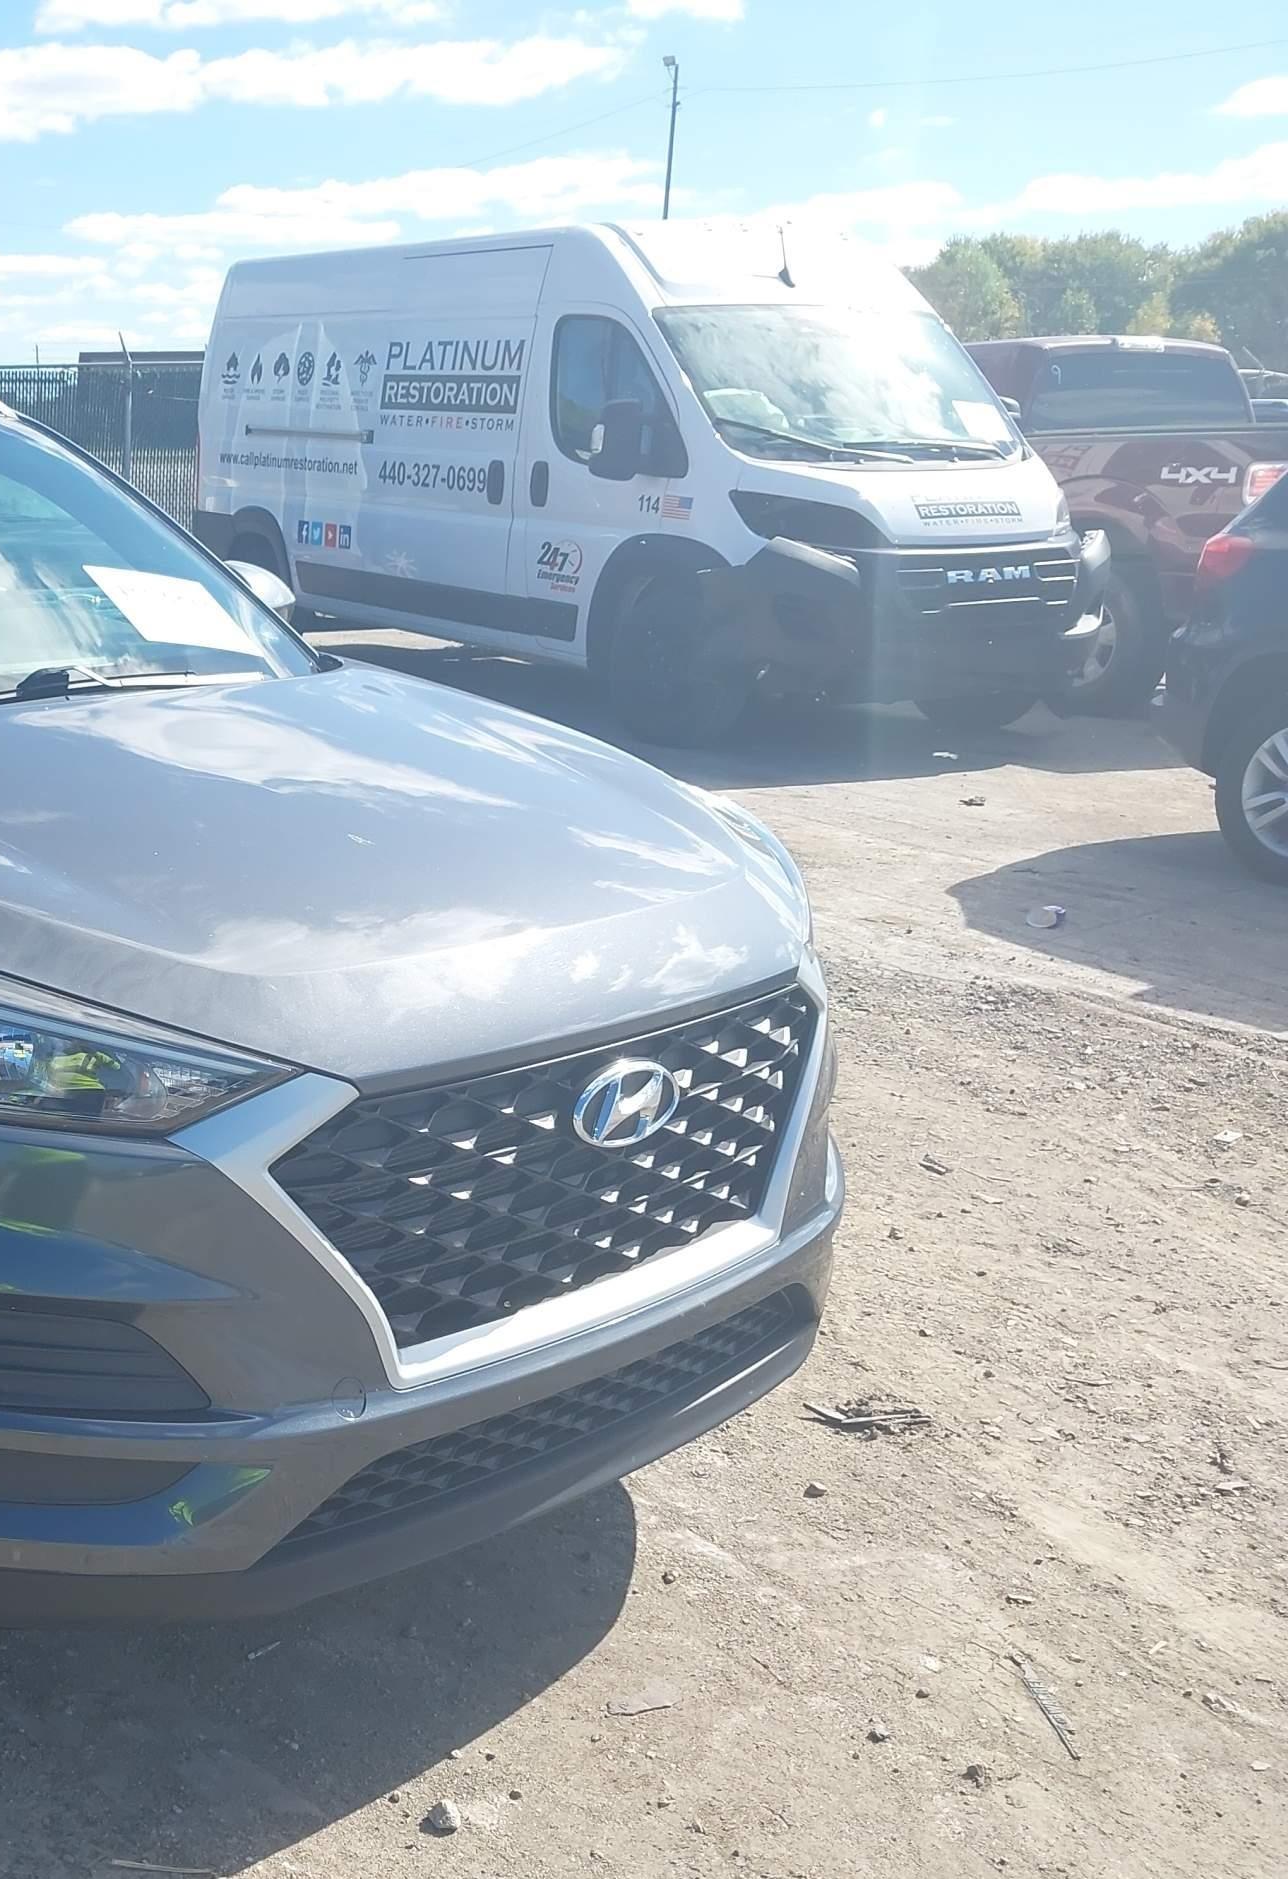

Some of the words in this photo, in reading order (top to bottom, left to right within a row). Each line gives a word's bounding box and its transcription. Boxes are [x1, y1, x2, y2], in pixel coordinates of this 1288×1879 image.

[385, 339, 527, 372] PLATINUM
[383, 381, 517, 407] RESTORATION
[380, 415, 423, 428] WATER
[431, 416, 463, 430] FIRE
[470, 418, 514, 432] STORM
[219, 452, 358, 476] www.callplatinumrestoration.net
[378, 460, 487, 494] 440-327-0699
[638, 494, 660, 514] 114
[917, 502, 1019, 518] RESTORATION
[946, 565, 1031, 584] RAM
